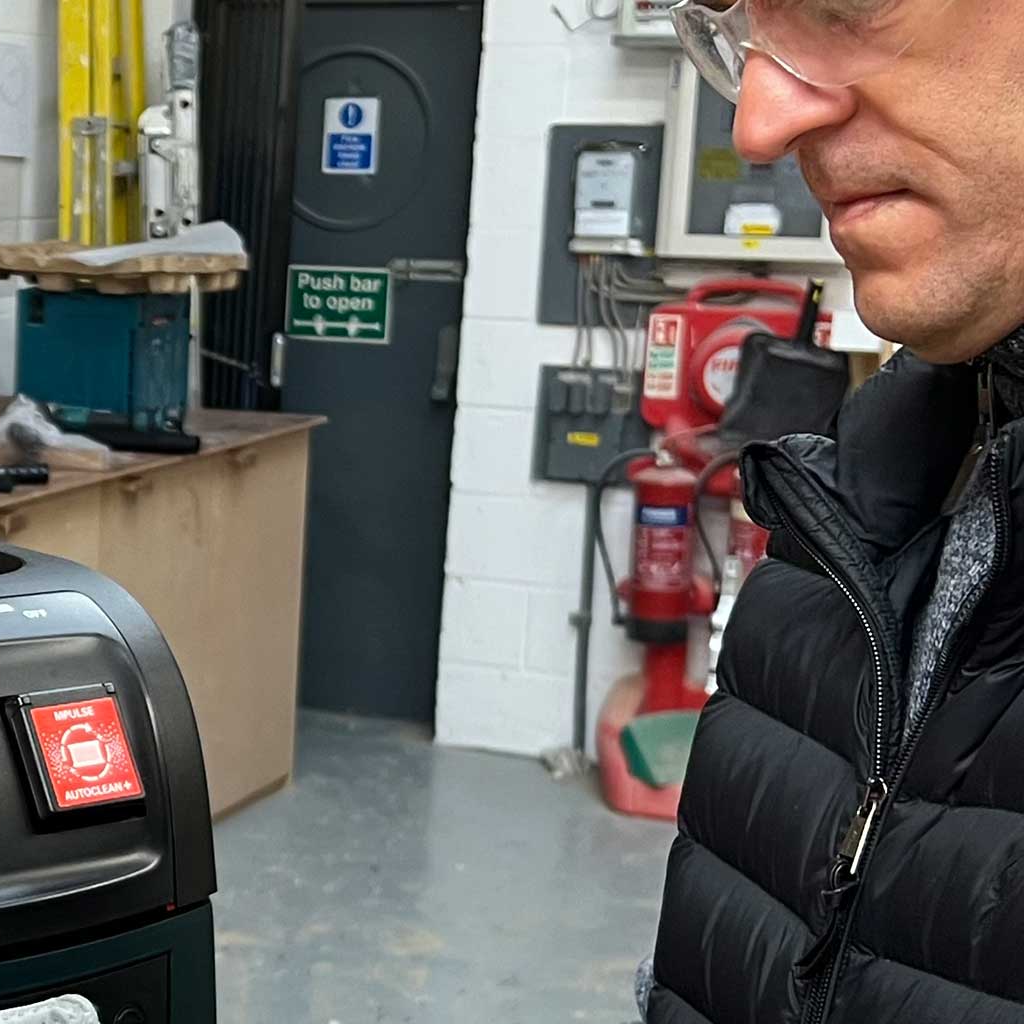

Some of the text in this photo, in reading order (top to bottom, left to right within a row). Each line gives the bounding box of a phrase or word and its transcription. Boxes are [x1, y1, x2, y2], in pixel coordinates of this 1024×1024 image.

[298, 272, 381, 293] Push bar
[303, 292, 374, 314] to open
[65, 782, 123, 801] AUTOCLEAN
